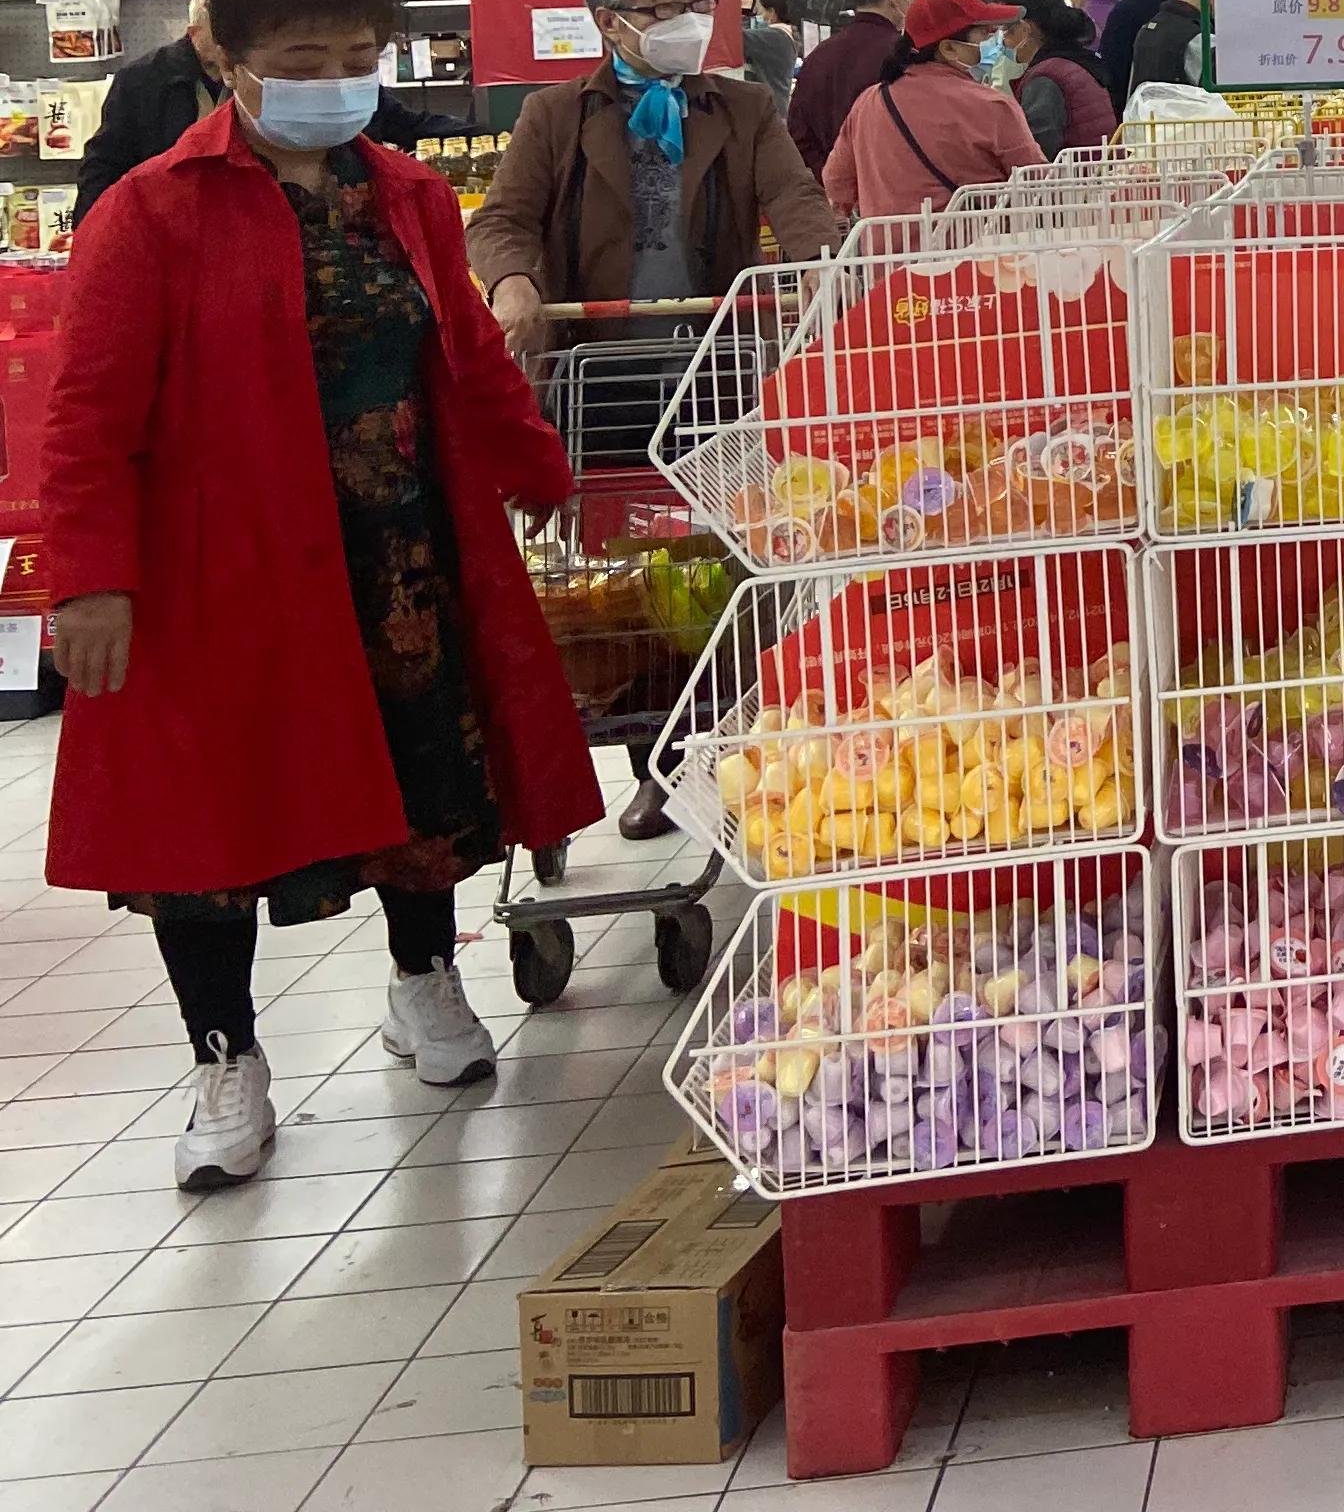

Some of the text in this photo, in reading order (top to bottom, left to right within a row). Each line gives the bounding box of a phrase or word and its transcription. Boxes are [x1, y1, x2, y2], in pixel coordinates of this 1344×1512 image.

[1272, 0, 1303, 15] 原价
[1258, 52, 1298, 66] 折扣价
